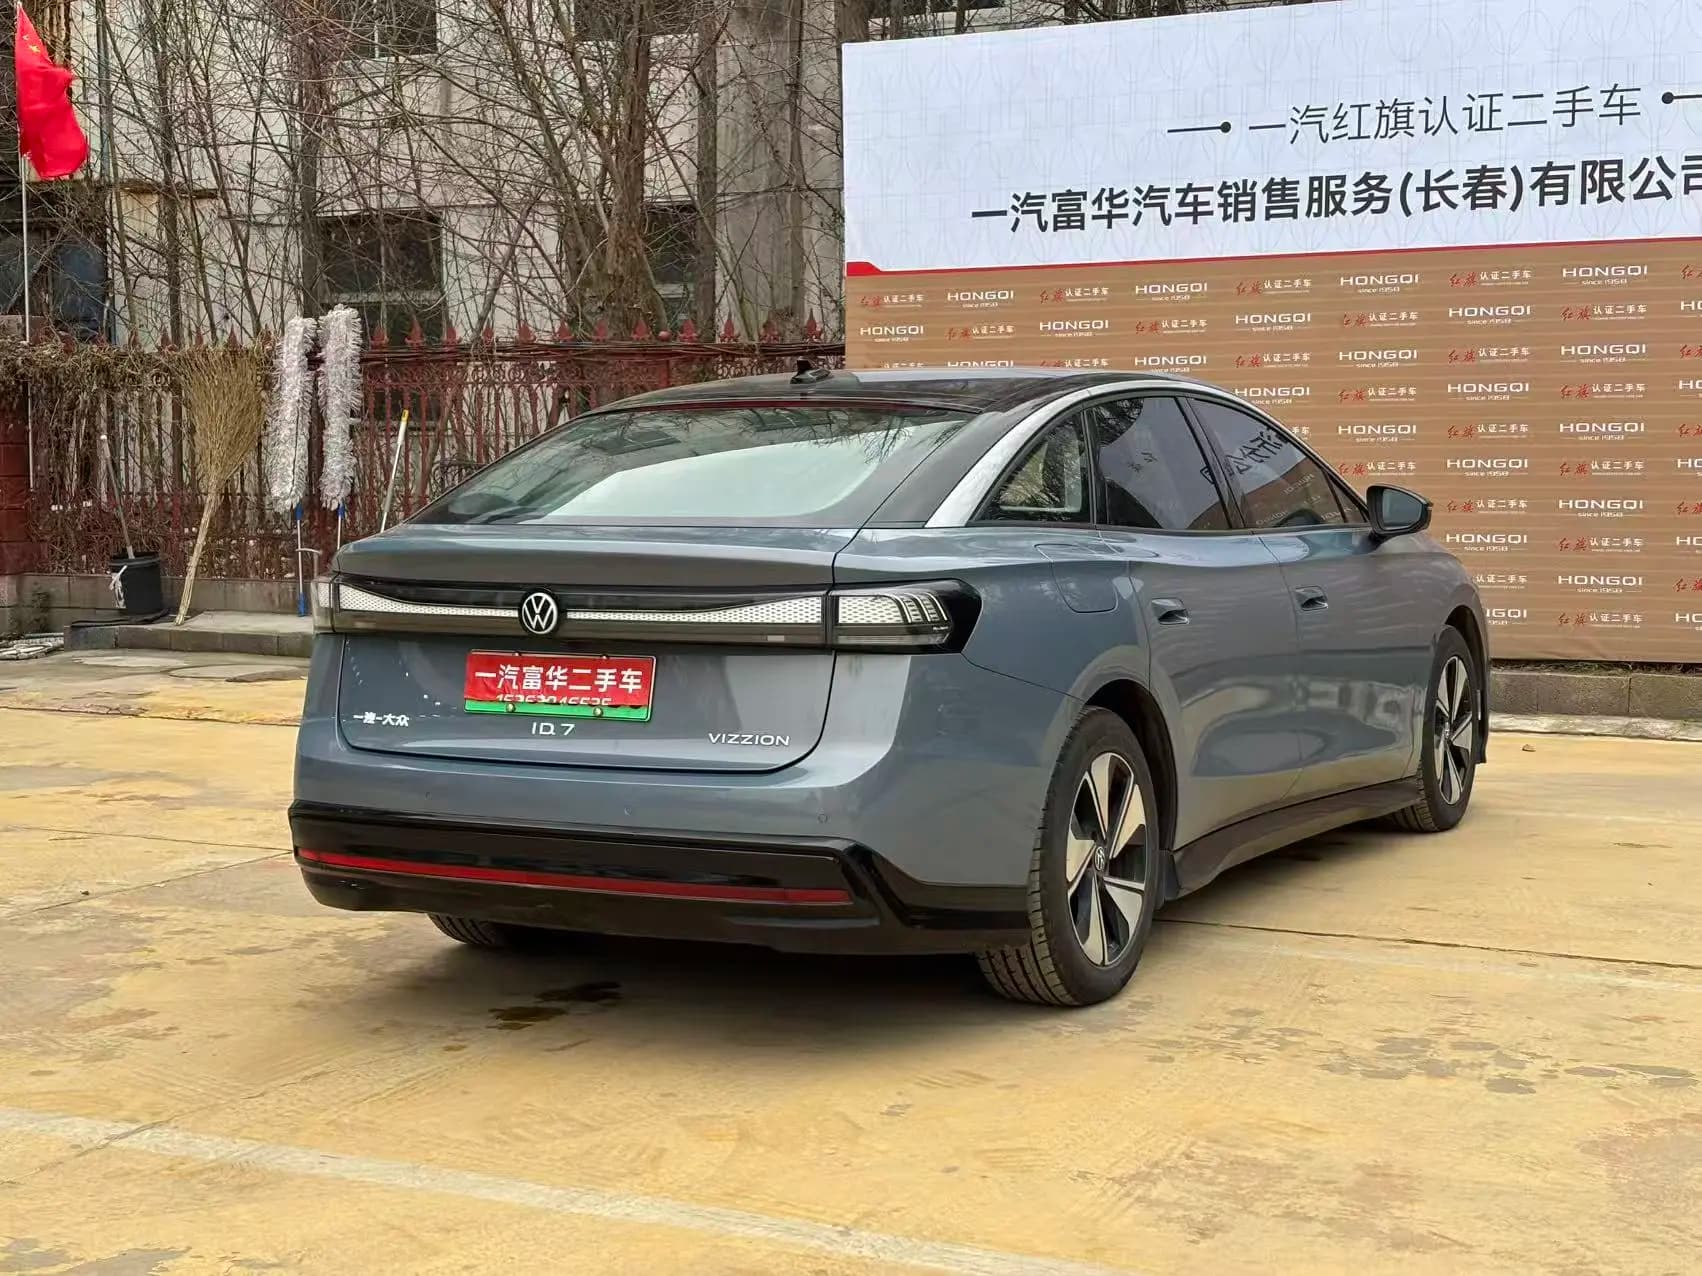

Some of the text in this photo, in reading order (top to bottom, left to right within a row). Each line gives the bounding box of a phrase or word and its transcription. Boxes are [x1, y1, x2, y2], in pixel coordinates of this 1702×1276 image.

[1249, 84, 1641, 146] 一汽红旗认证二手车
[1562, 265, 1648, 278] HONGQI
[1340, 273, 1419, 286] HONGQI
[1135, 282, 1208, 294] HONGQI
[947, 290, 1014, 301] HONGQI
[1448, 305, 1531, 317] HONGQI
[1235, 312, 1311, 325] HONGQI
[860, 325, 924, 336] HONGQI
[1039, 319, 1109, 331] HONGQI
[1339, 349, 1418, 361] HONGQI
[1560, 343, 1646, 356] HONGQI
[1134, 355, 1207, 366] HONGQI
[1235, 386, 1310, 397] HONGQI
[1447, 382, 1529, 393] HONGQI
[1338, 424, 1417, 435] HONGQI
[1559, 422, 1645, 433] HONGQI
[1446, 458, 1528, 469] HONGQI
[1558, 499, 1644, 510] HONGQI
[1446, 533, 1528, 545] HONGQI
[1475, 574, 1528, 584] 认证二手车
[1558, 575, 1643, 587] HONGQI
[1486, 608, 1528, 619] GQI
[475, 664, 643, 693] 一汽富华二手车
[708, 732, 790, 746] VIZZION
